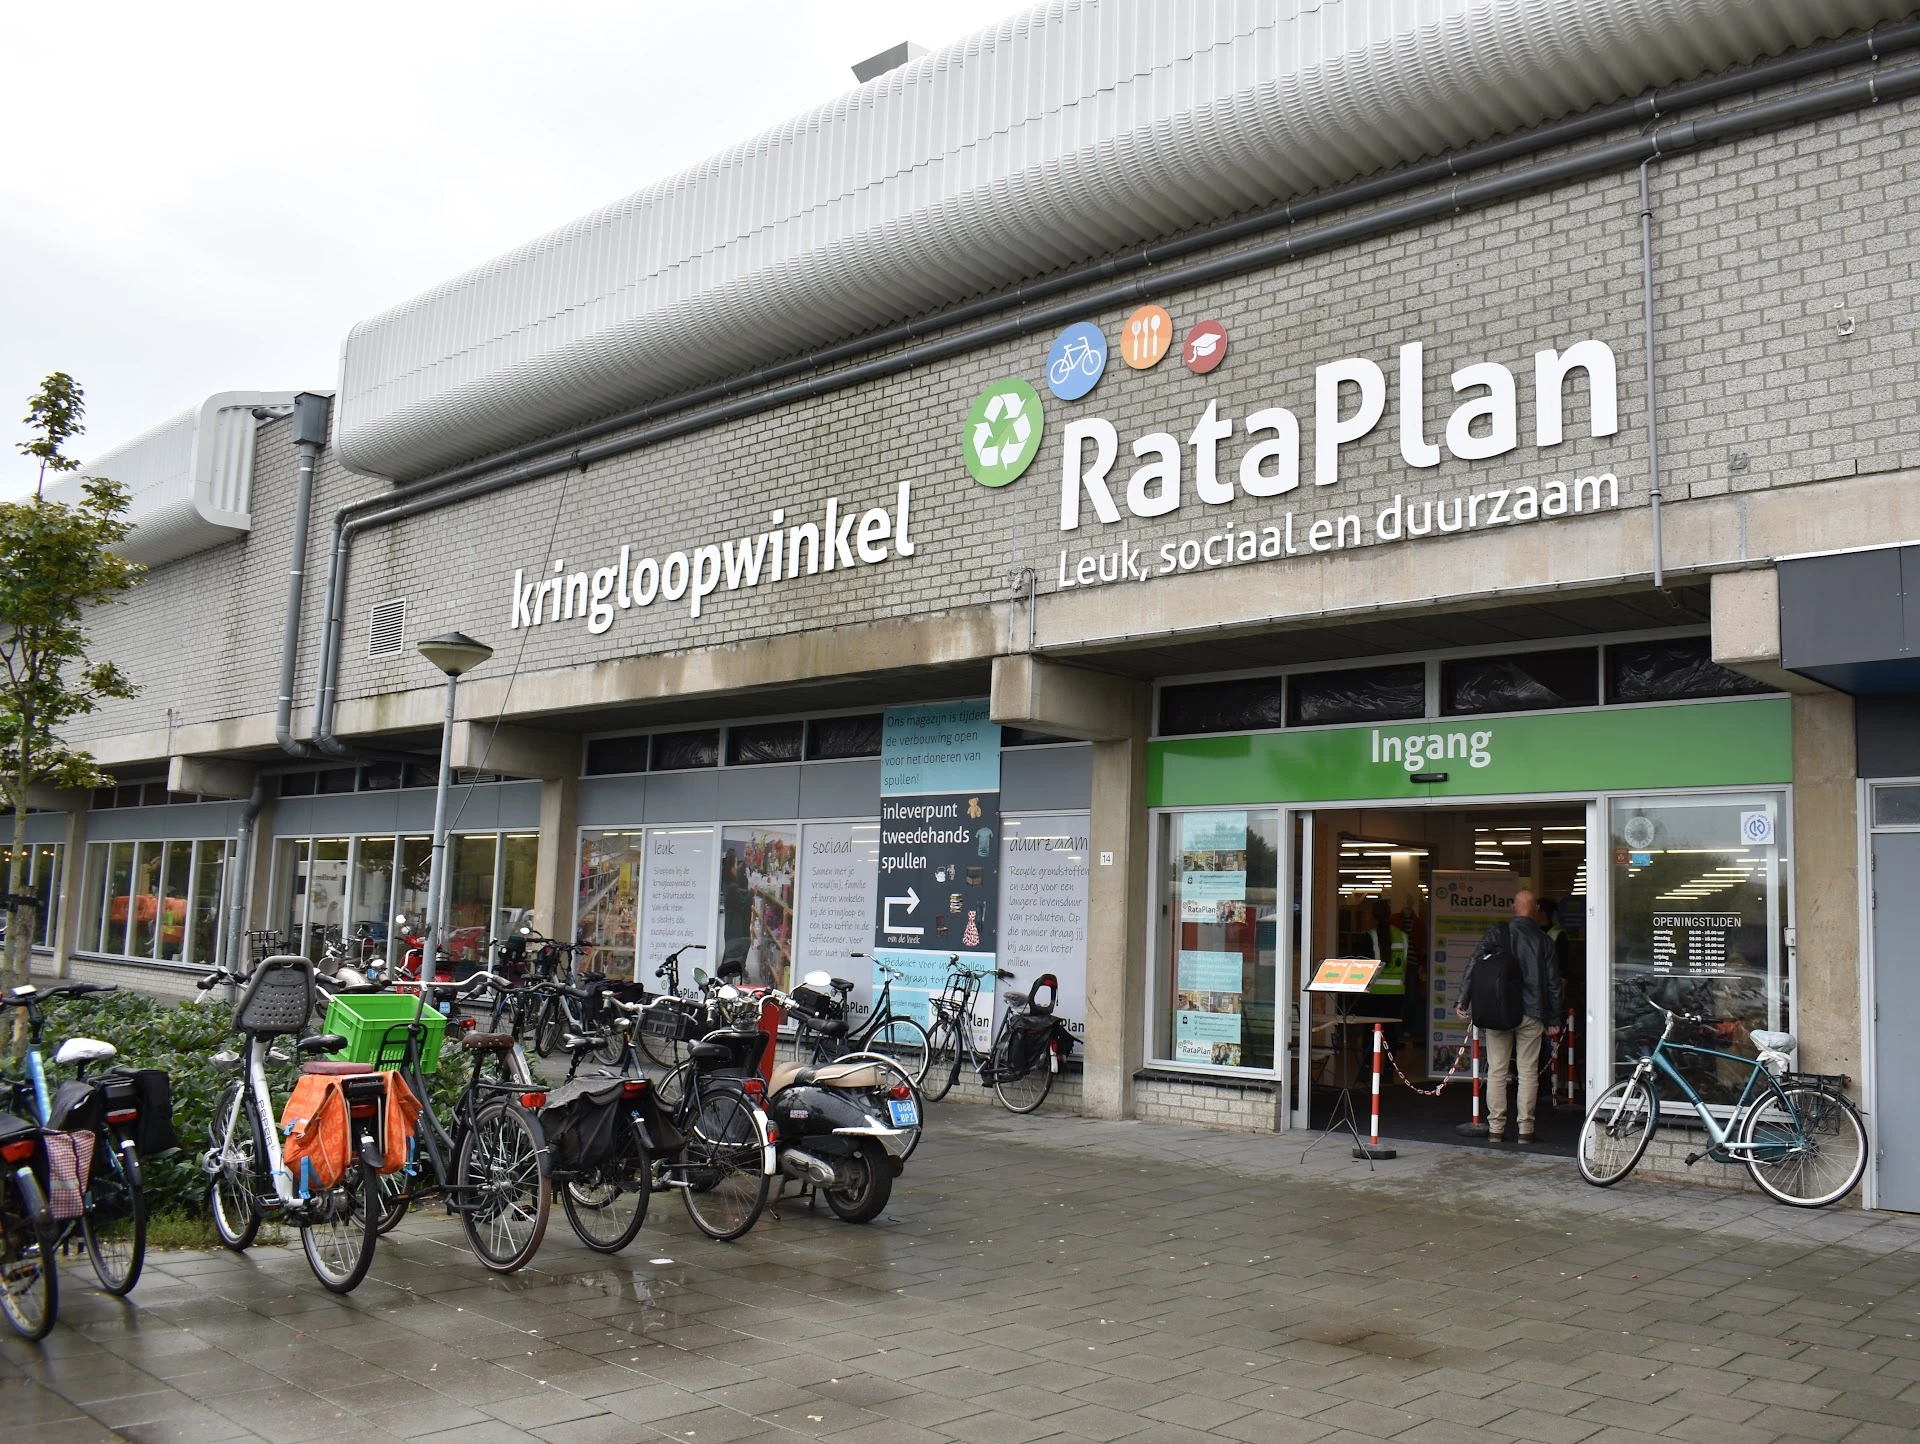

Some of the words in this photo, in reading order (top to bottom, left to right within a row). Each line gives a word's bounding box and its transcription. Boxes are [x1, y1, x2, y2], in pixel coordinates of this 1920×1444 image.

[1059, 339, 1619, 530] RataPlan
[1058, 537, 1149, 587] Leuk,
[1159, 512, 1296, 575] sociaal
[1309, 513, 1361, 552] en
[1376, 472, 1620, 541] duurzaam
[511, 480, 915, 635] kringloopwinkel
[887, 716, 904, 728] Ons
[907, 713, 947, 729] magazijn
[950, 712, 958, 723] is
[886, 734, 898, 747] de
[900, 732, 952, 746] verbouwing
[954, 731, 978, 746] open
[1372, 729, 1493, 772] Ingang
[885, 755, 904, 767] voor
[907, 753, 921, 766] het
[923, 752, 962, 764] doneren
[965, 751, 981, 762] van
[884, 773, 919, 789] spullen!
[883, 802, 958, 823] inleverpunt
[882, 826, 970, 845] tweedehands
[1009, 831, 1088, 852] duurzaam
[654, 839, 675, 856] leuk
[812, 836, 852, 855] sociaal
[881, 852, 927, 874] spullen
[1102, 854, 1112, 864] 14
[812, 866, 833, 876] Samen
[834, 868, 847, 876] met
[848, 868, 855, 878] je
[1009, 865, 1037, 876] Recycle
[844, 880, 867, 890] familie
[1009, 883, 1018, 891] en
[1020, 883, 1039, 895] zorg
[1040, 883, 1058, 892] voor
[1060, 883, 1074, 892] een
[810, 892, 818, 903] of
[818, 893, 837, 903] buren
[838, 894, 865, 903] winkelen
[1009, 896, 1037, 910] langere
[1039, 896, 1083, 907] levensduur
[818, 906, 826, 915] de
[827, 906, 856, 920] kringloop
[857, 909, 865, 917] en
[1187, 904, 1216, 914] RataPlan
[1008, 913, 1023, 922] van
[1025, 911, 1066, 923] producten.
[1068, 912, 1081, 923] Op
[1653, 917, 1742, 927] OPENINGSTIJDEN
[809, 920, 820, 929] een
[821, 920, 833, 931] kop
[834, 920, 852, 931] koffie
[861, 920, 869, 931] de
[1007, 926, 1019, 936] die
[1021, 928, 1048, 937] manier
[1049, 927, 1074, 941] draag
[1075, 928, 1084, 941] jij
[808, 949, 823, 957] ieder
[825, 949, 838, 957] wat
[1007, 940, 1017, 954] bij
[1018, 944, 1033, 952] aan
[1035, 944, 1049, 952] een
[1051, 942, 1074, 954] beter
[918, 961, 936, 969] voor
[1007, 957, 1031, 968] milieu.
[905, 974, 928, 987] graag
[930, 975, 946, 984] tot
[1182, 1045, 1211, 1056] RataPlan
